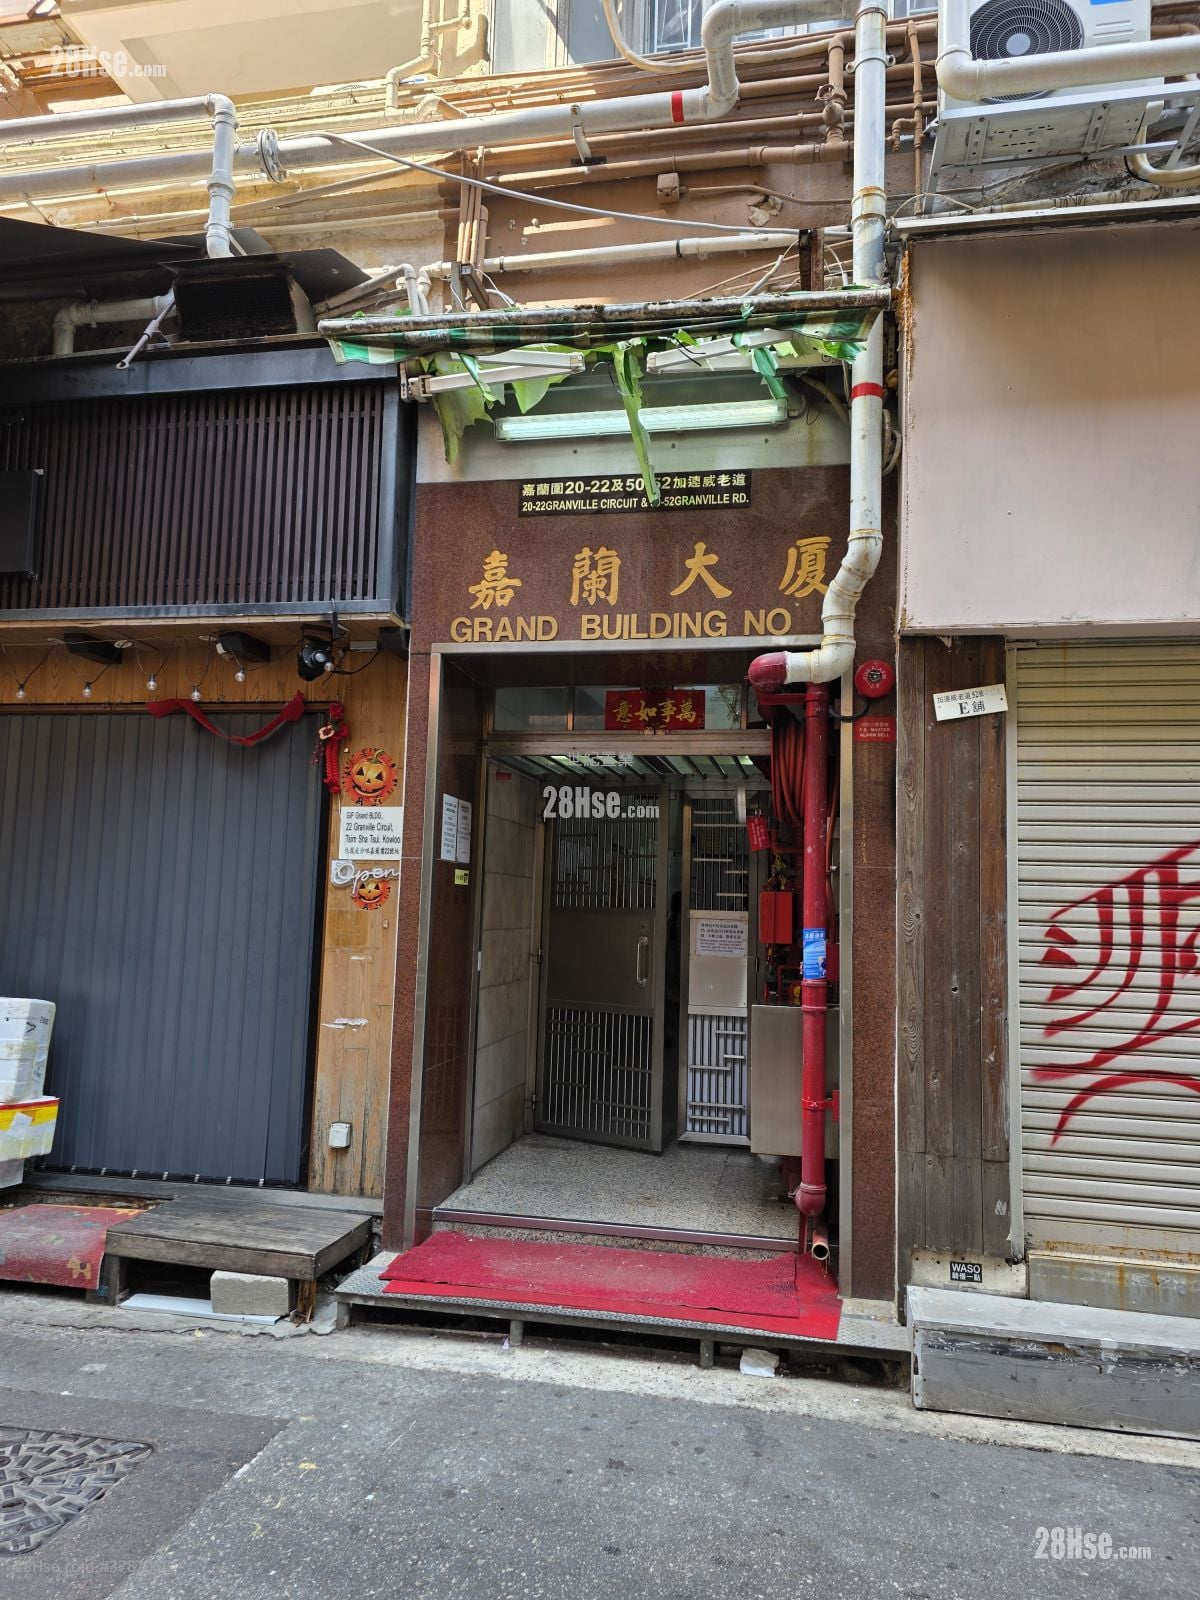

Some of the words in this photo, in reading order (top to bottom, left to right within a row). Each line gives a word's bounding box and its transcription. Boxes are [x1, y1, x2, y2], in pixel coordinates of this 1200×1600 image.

[522, 473, 747, 497] 嘉蘭圍20-22及5052加連威老道
[522, 499, 598, 512] 20-22GRANVILLE
[600, 497, 638, 509] CIRCUIT
[641, 497, 648, 508] &
[732, 493, 749, 504] RD.
[468, 536, 832, 610] 嘉蘭大廈
[450, 615, 559, 643] GRAND
[581, 609, 727, 640] BUILDING
[744, 607, 792, 637] NO
[345, 822, 352, 831] 22
[353, 822, 375, 831] Granville
[345, 834, 357, 844] Tsim
[358, 834, 369, 844] Sha
[333, 863, 400, 897] Open
[951, 1263, 981, 1274] WASO
